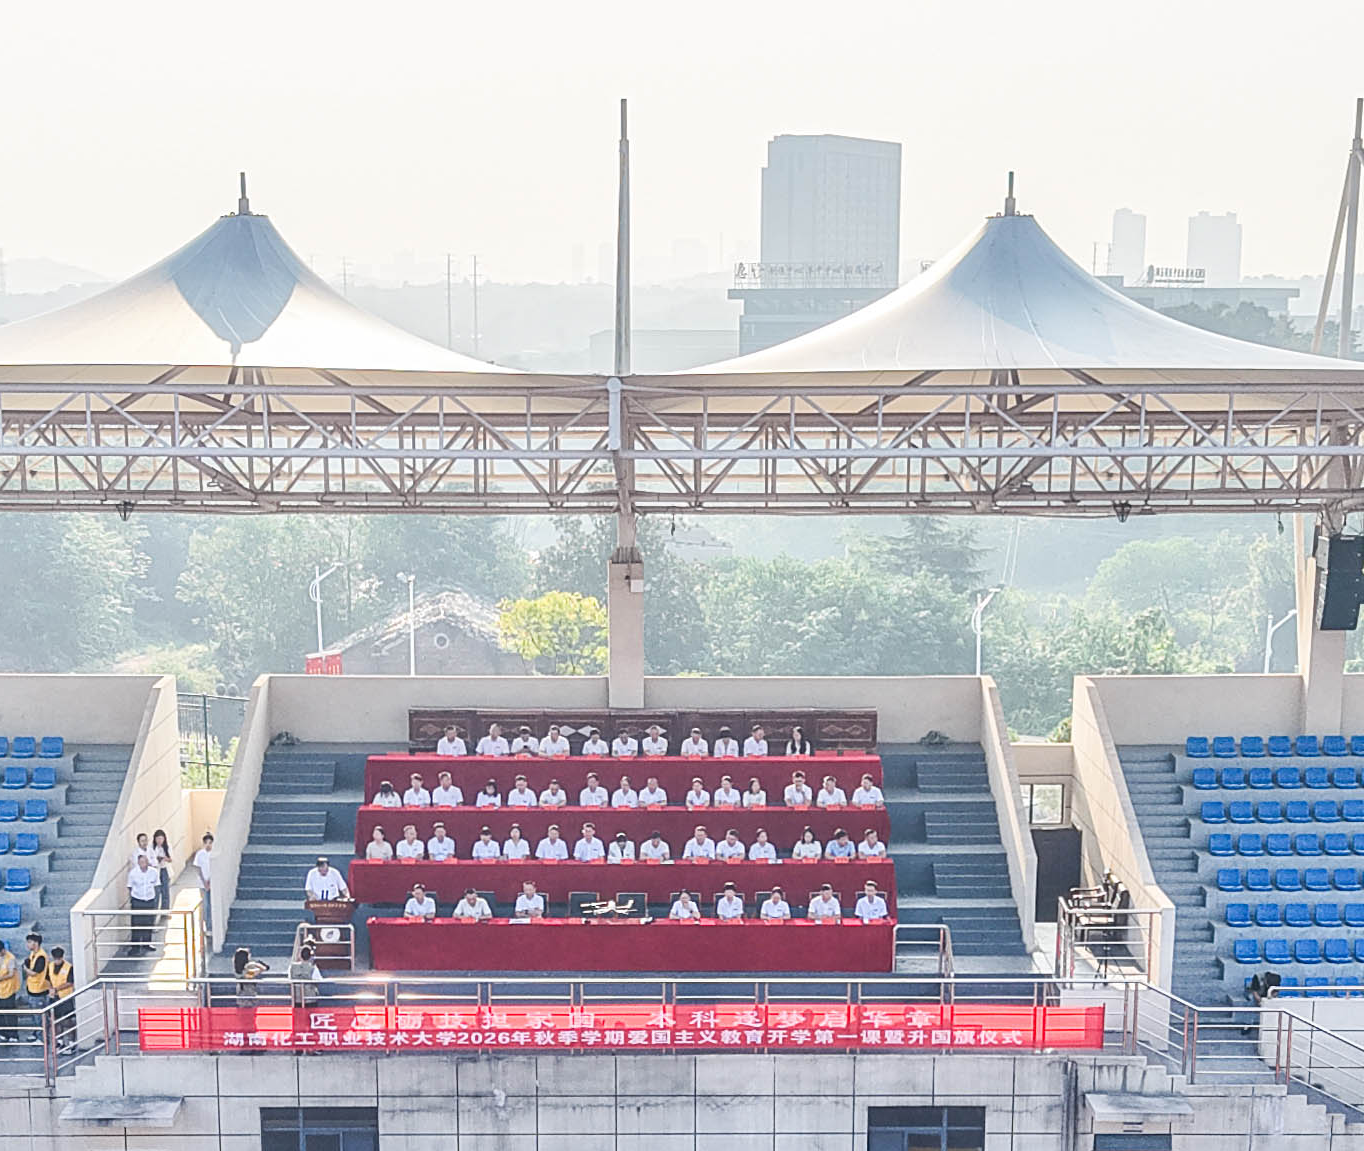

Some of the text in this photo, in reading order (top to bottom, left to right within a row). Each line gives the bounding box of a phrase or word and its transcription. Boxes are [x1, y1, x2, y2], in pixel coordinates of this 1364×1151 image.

[223, 1030, 1023, 1047] 湖南化工职业技术大学2026年秋季学期爱国主义教育开学第一课暨升国旗仪式
